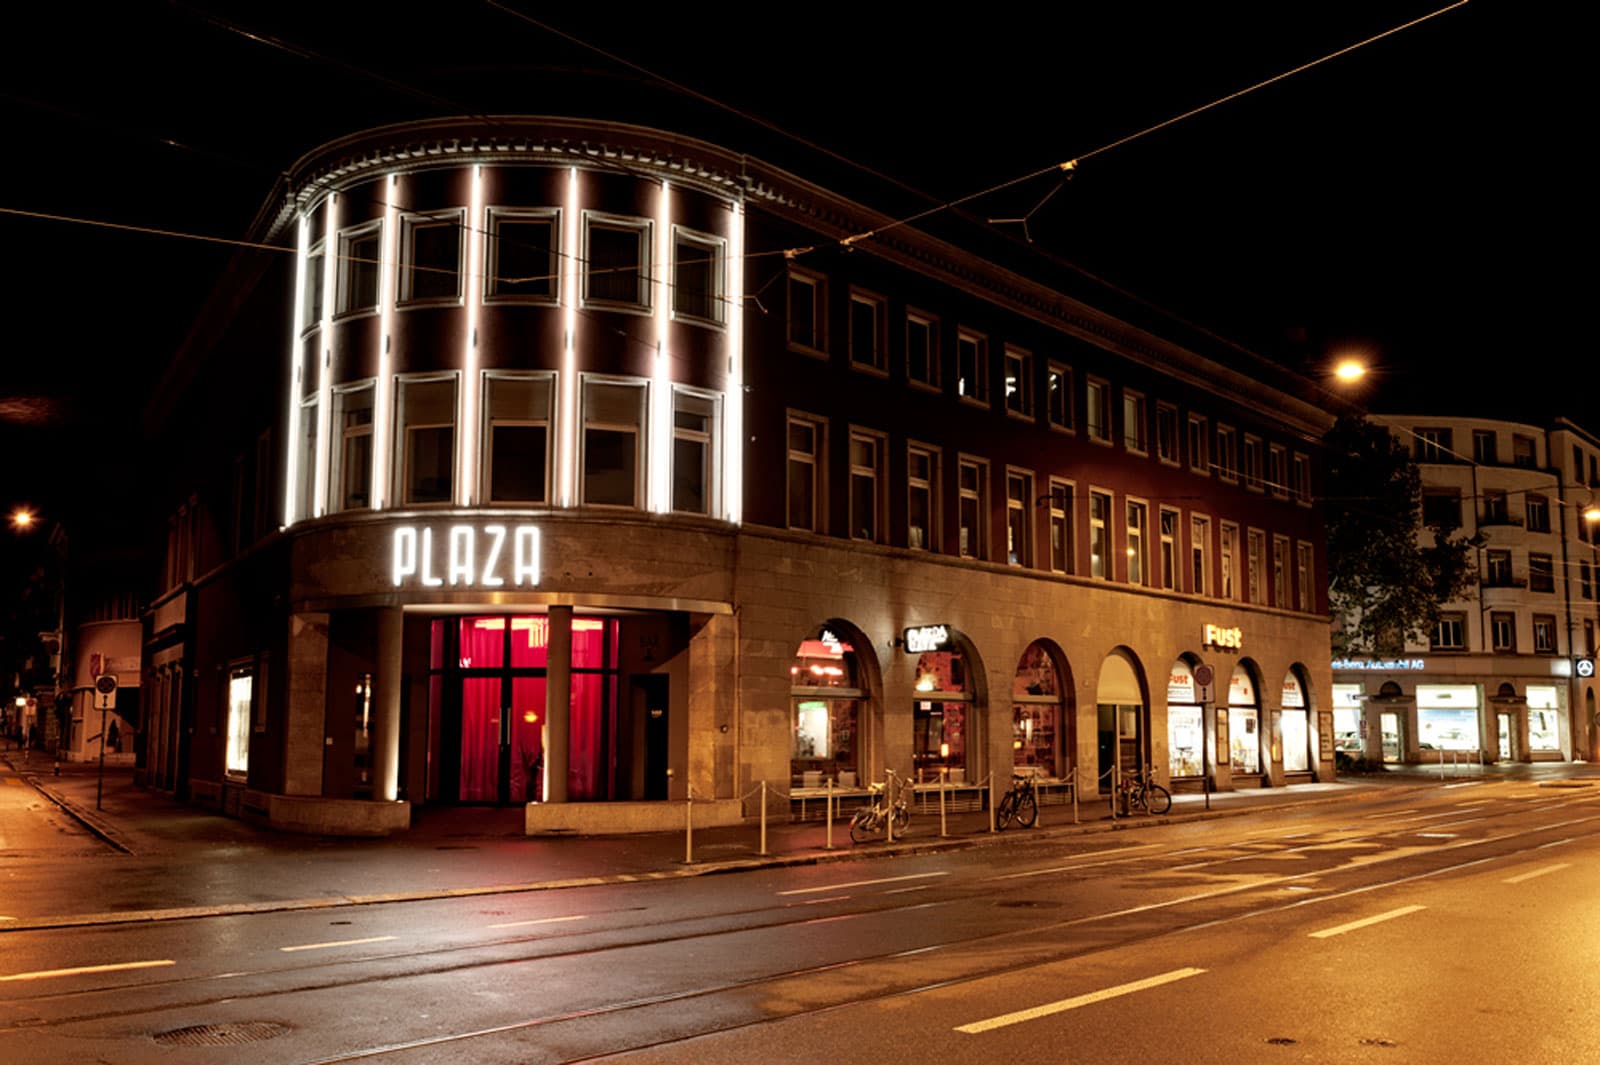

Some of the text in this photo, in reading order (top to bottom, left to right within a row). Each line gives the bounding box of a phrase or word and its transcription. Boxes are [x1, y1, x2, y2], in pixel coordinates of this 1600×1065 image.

[392, 525, 541, 587] PLAZA
[1206, 624, 1242, 648] Fust
[1411, 659, 1425, 669] AG
